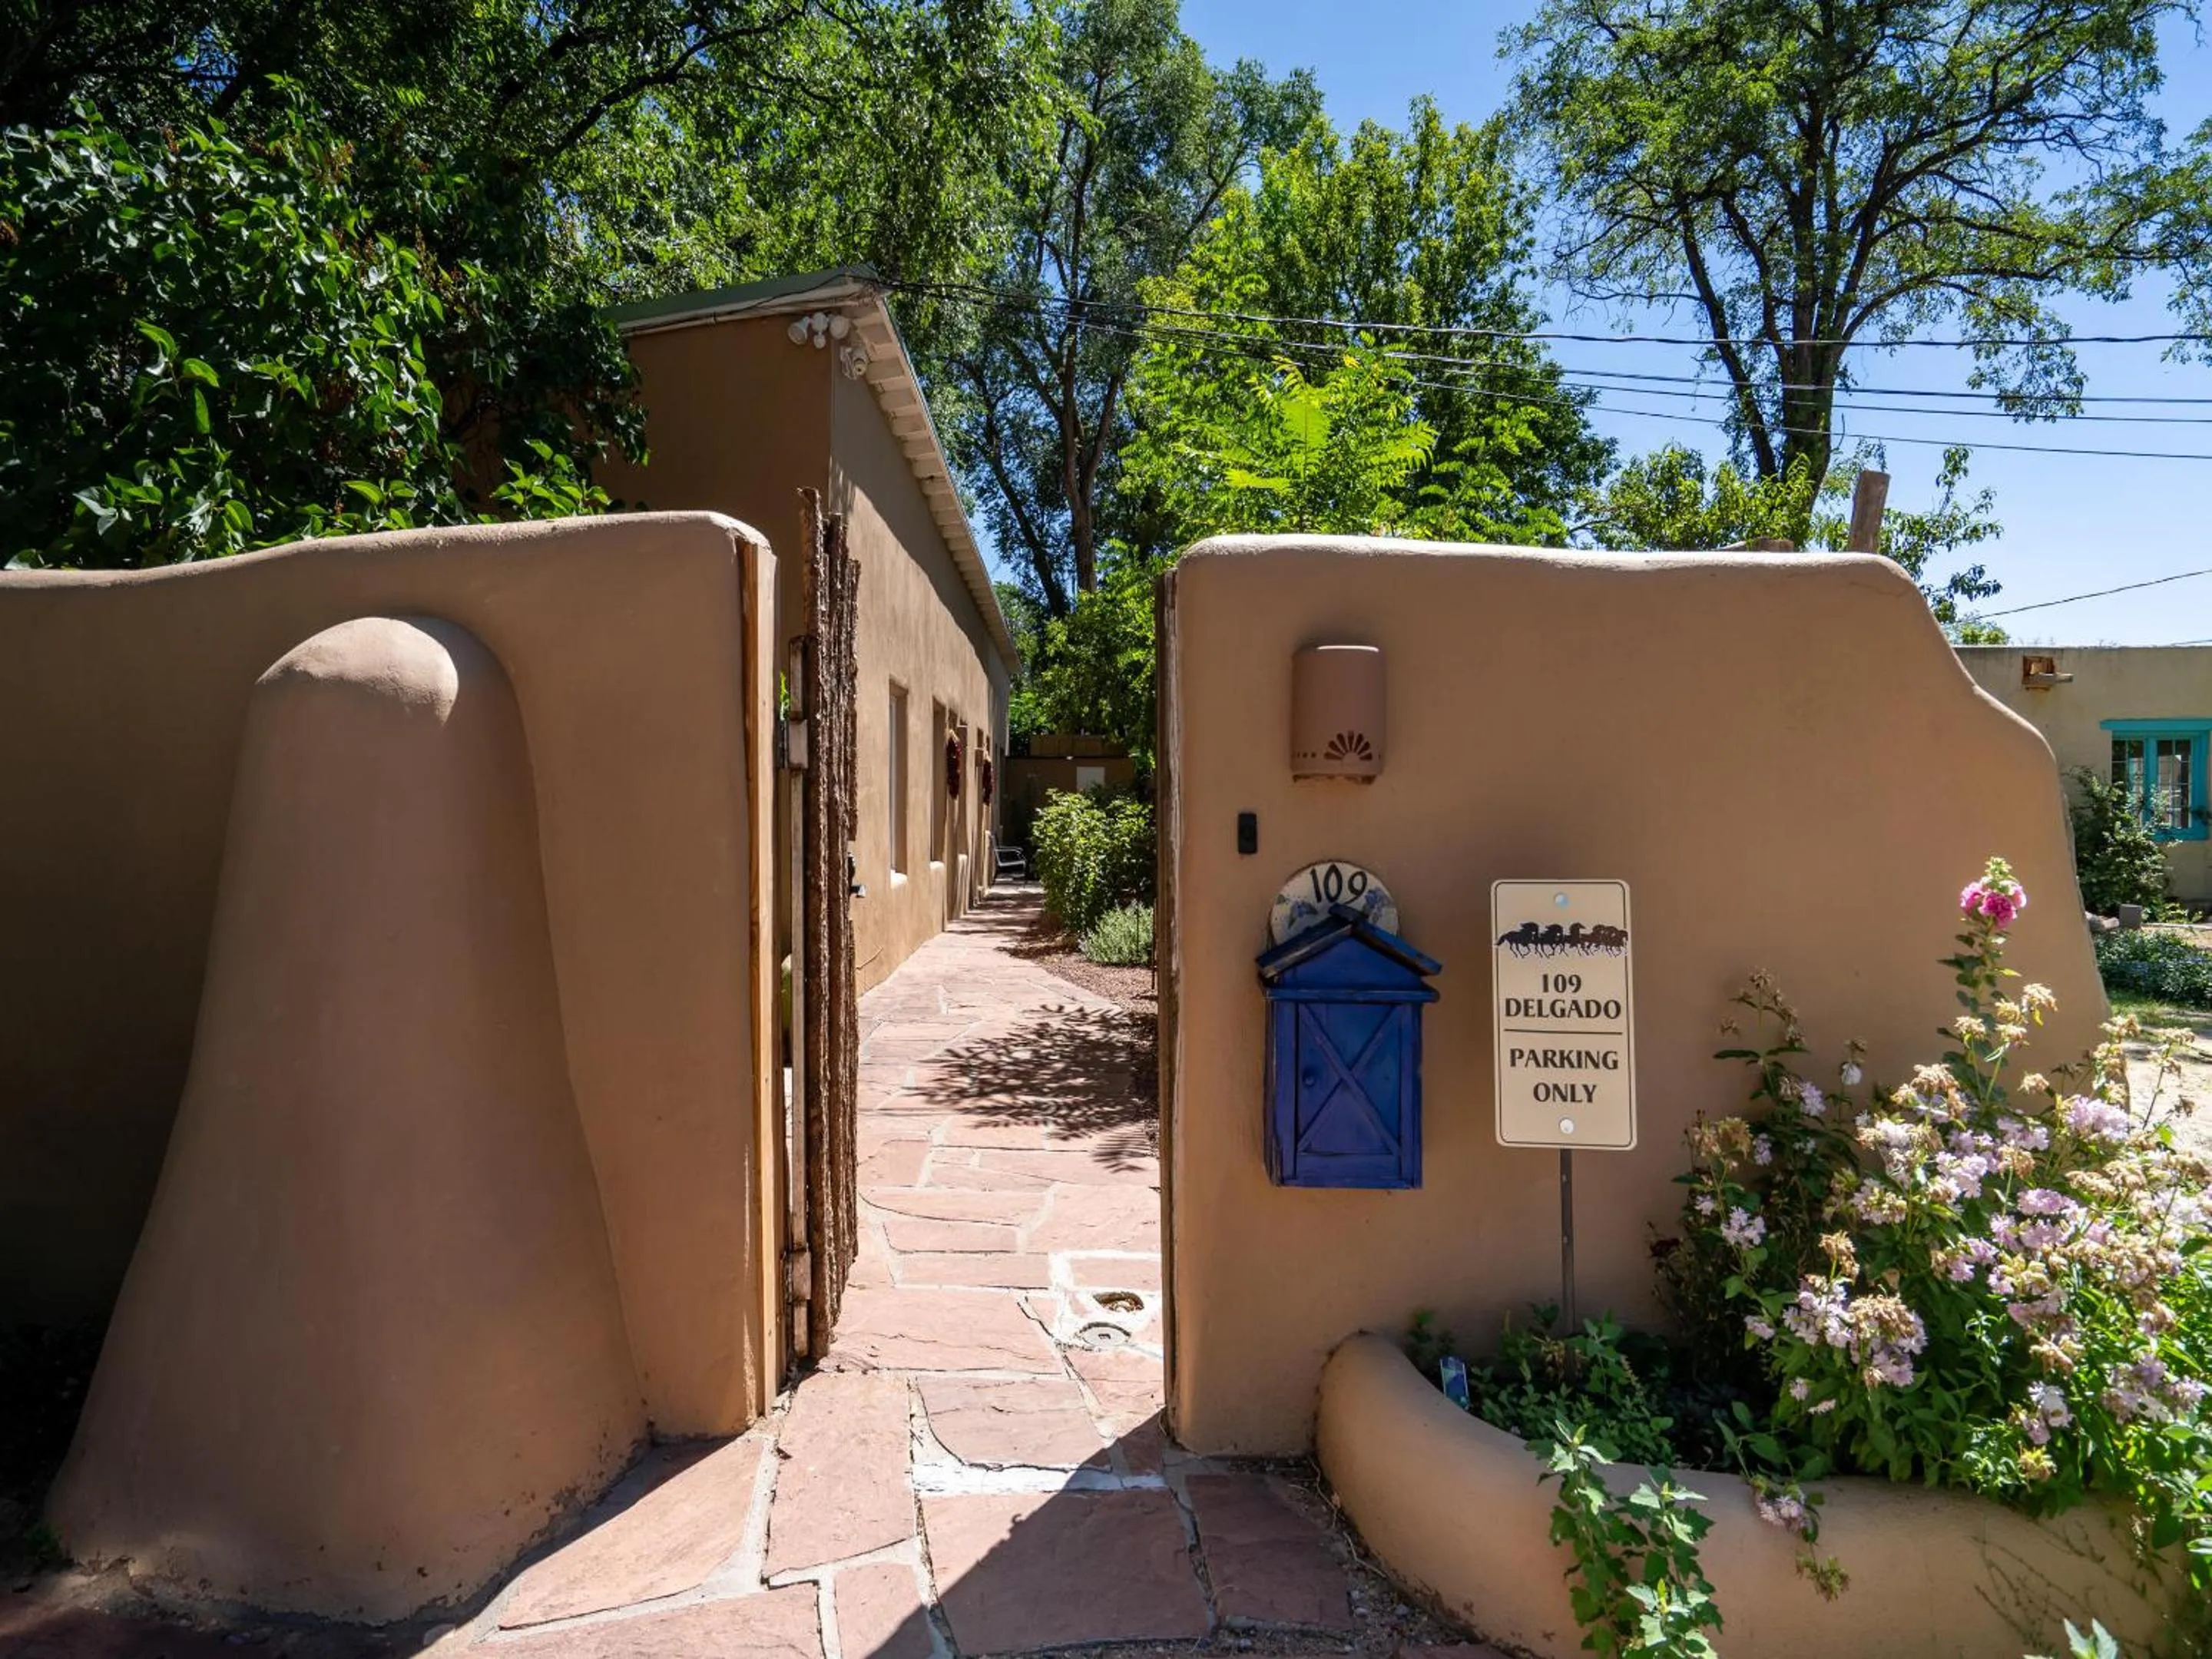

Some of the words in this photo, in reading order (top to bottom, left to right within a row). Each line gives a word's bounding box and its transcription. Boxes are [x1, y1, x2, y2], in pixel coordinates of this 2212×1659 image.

[1310, 863, 1368, 905] 109
[1541, 973, 1582, 994] 109
[1505, 998, 1622, 1019] DELGADO
[1509, 1048, 1619, 1070] PARKING
[1533, 1081, 1598, 1104] ONLY
